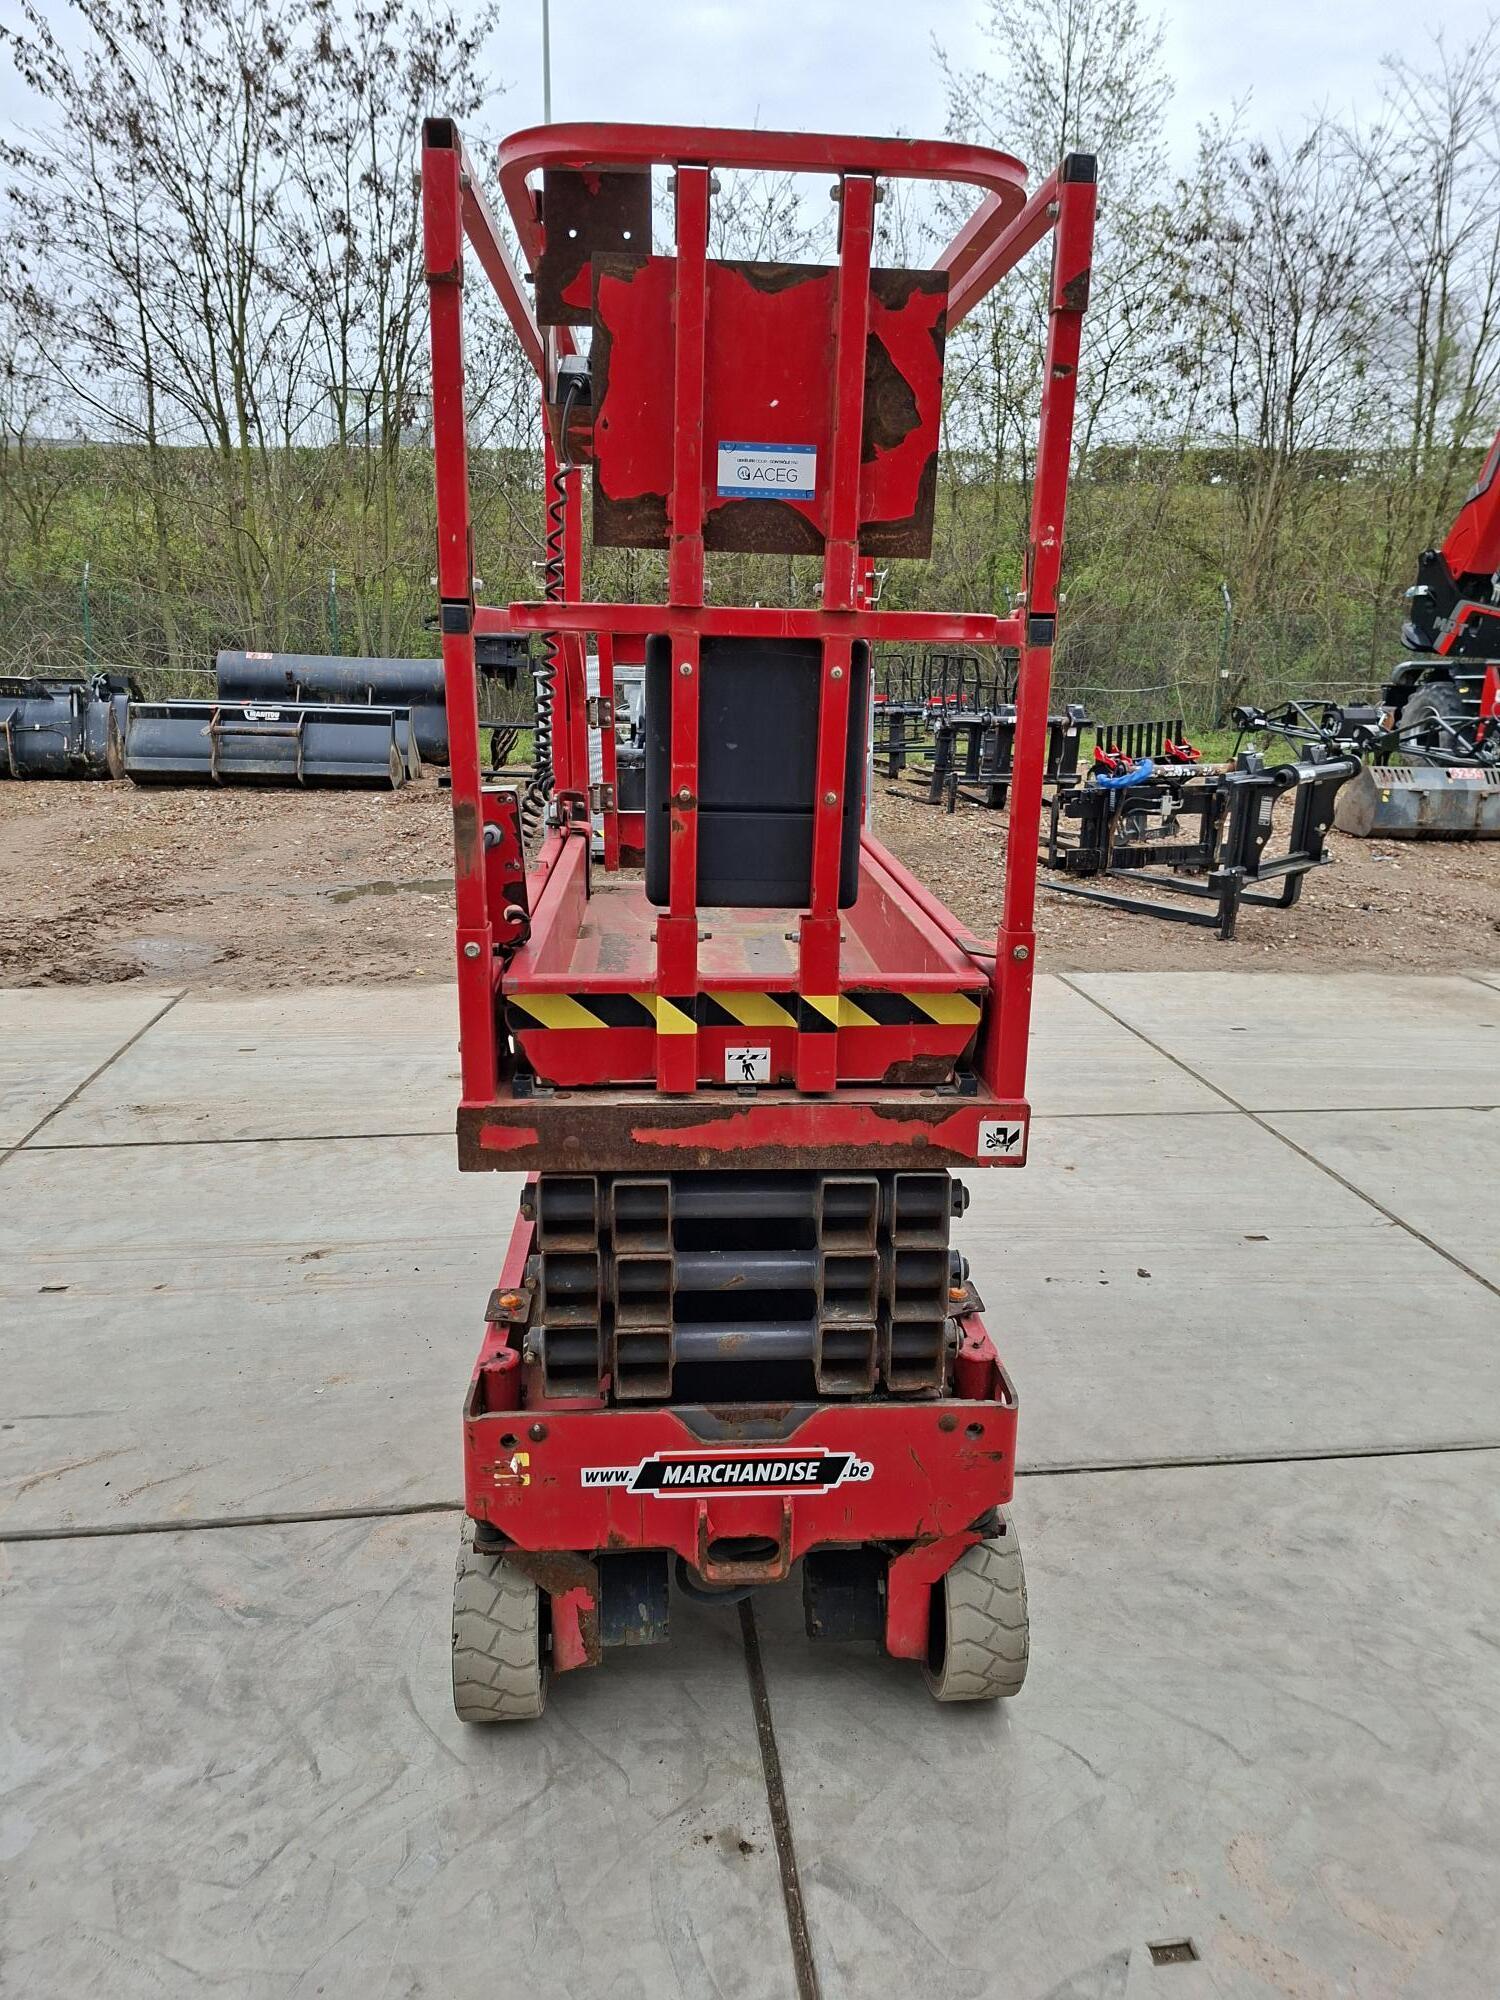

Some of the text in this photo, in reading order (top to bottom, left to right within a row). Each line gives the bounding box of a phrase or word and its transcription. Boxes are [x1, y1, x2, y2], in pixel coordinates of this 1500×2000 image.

[752, 467, 798, 483] ACEG
[249, 710, 280, 718] MANITOU
[585, 1462, 870, 1484] www. MARCHANDISE .be
